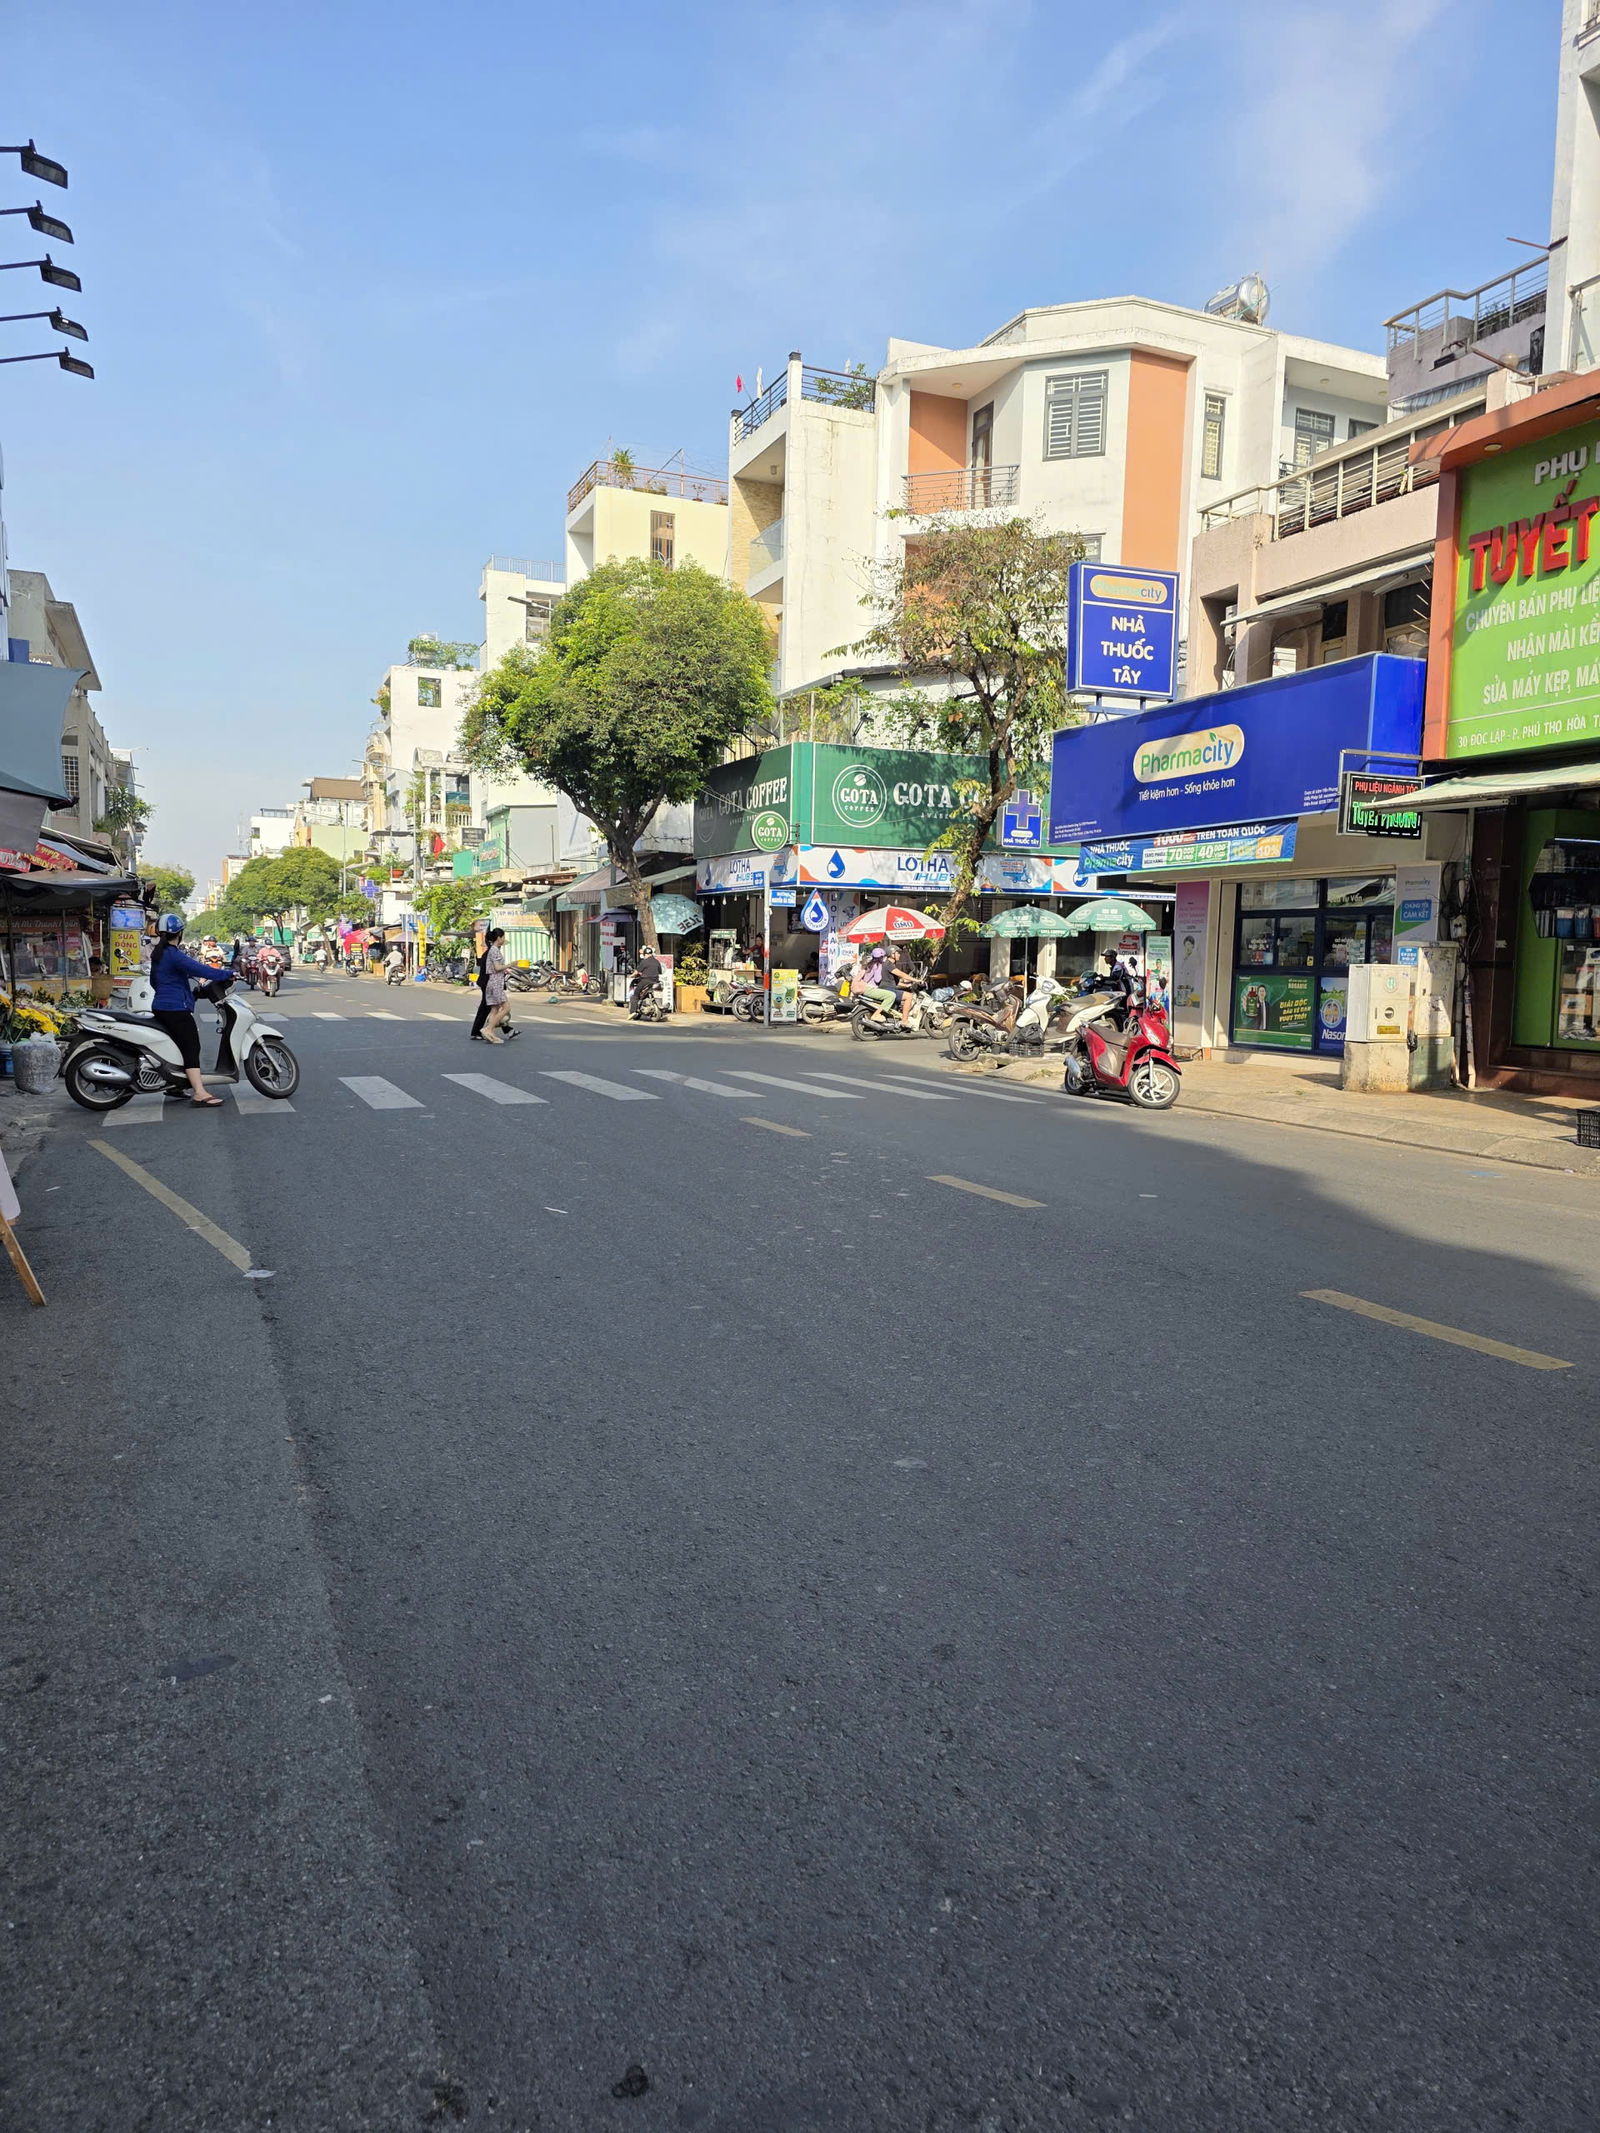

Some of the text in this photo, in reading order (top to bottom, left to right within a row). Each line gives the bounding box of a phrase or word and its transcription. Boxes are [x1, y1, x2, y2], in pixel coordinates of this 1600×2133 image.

[1535, 446, 1588, 485] PHỤ
[1468, 480, 1600, 592] TUYẾT
[1466, 600, 1515, 632] CHUYÊN
[1519, 589, 1546, 620] BÁN
[1550, 584, 1577, 613] PHỤ
[1111, 615, 1146, 633] NHÀ
[1100, 638, 1154, 660] THUỐC
[1507, 632, 1546, 662] NHẬN
[1549, 624, 1576, 653] MÀI
[1112, 665, 1142, 685] TÂY
[1483, 674, 1508, 704] SỬA
[1512, 670, 1542, 699] MÁY
[1458, 735, 1468, 748] 30
[1522, 721, 1541, 739] PHÚ
[1544, 720, 1562, 736] THỌ
[1567, 713, 1587, 731] HÒA
[1141, 736, 1234, 775] Pharmacity
[746, 777, 788, 810] COFFEE
[840, 787, 879, 805] GOTA
[893, 782, 953, 808] GOTA
[758, 827, 782, 837] GOTA
[729, 858, 751, 874] LOTHA
[897, 856, 949, 876] LOTHA
[893, 920, 914, 931] OMO
